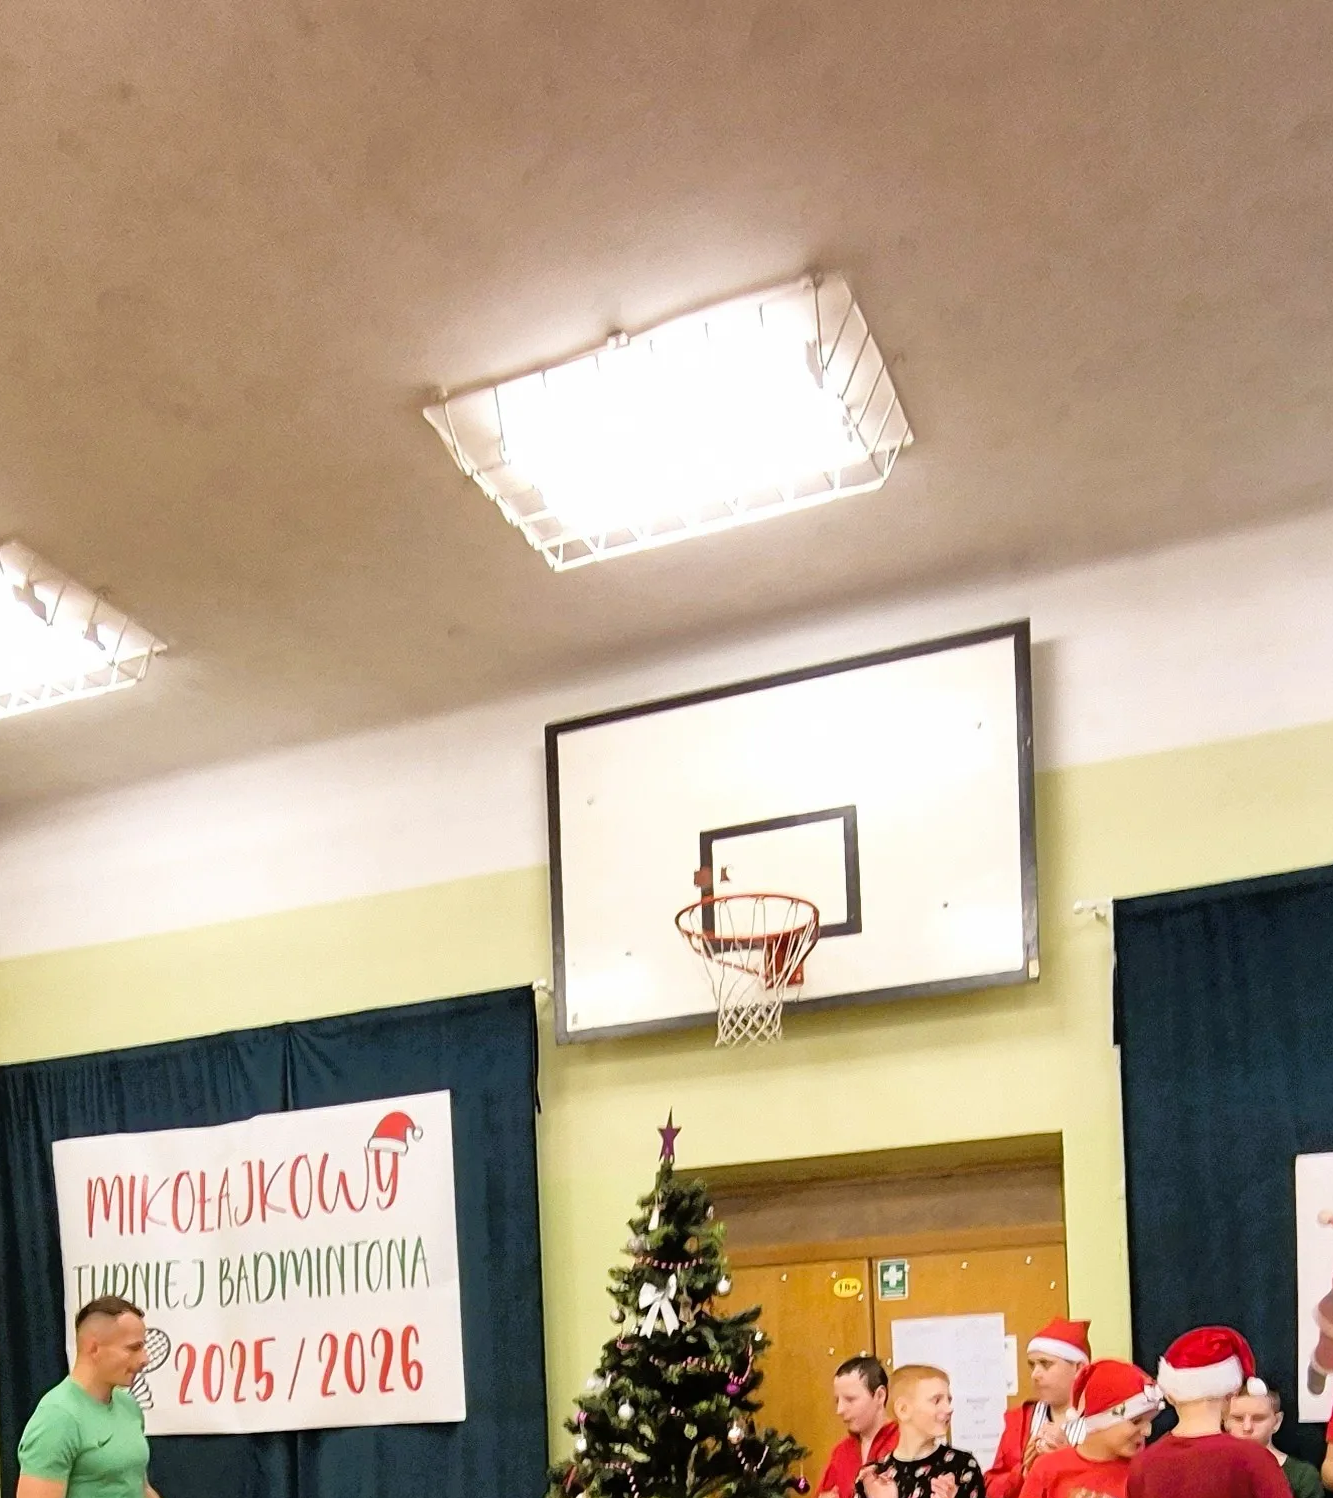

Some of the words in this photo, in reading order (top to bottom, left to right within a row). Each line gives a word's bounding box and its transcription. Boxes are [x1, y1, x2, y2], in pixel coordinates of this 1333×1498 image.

[85, 1146, 399, 1239] MIKOŁAJKOWY
[72, 1259, 206, 1311] TURNIEJ
[218, 1235, 430, 1307] BADMINTONA
